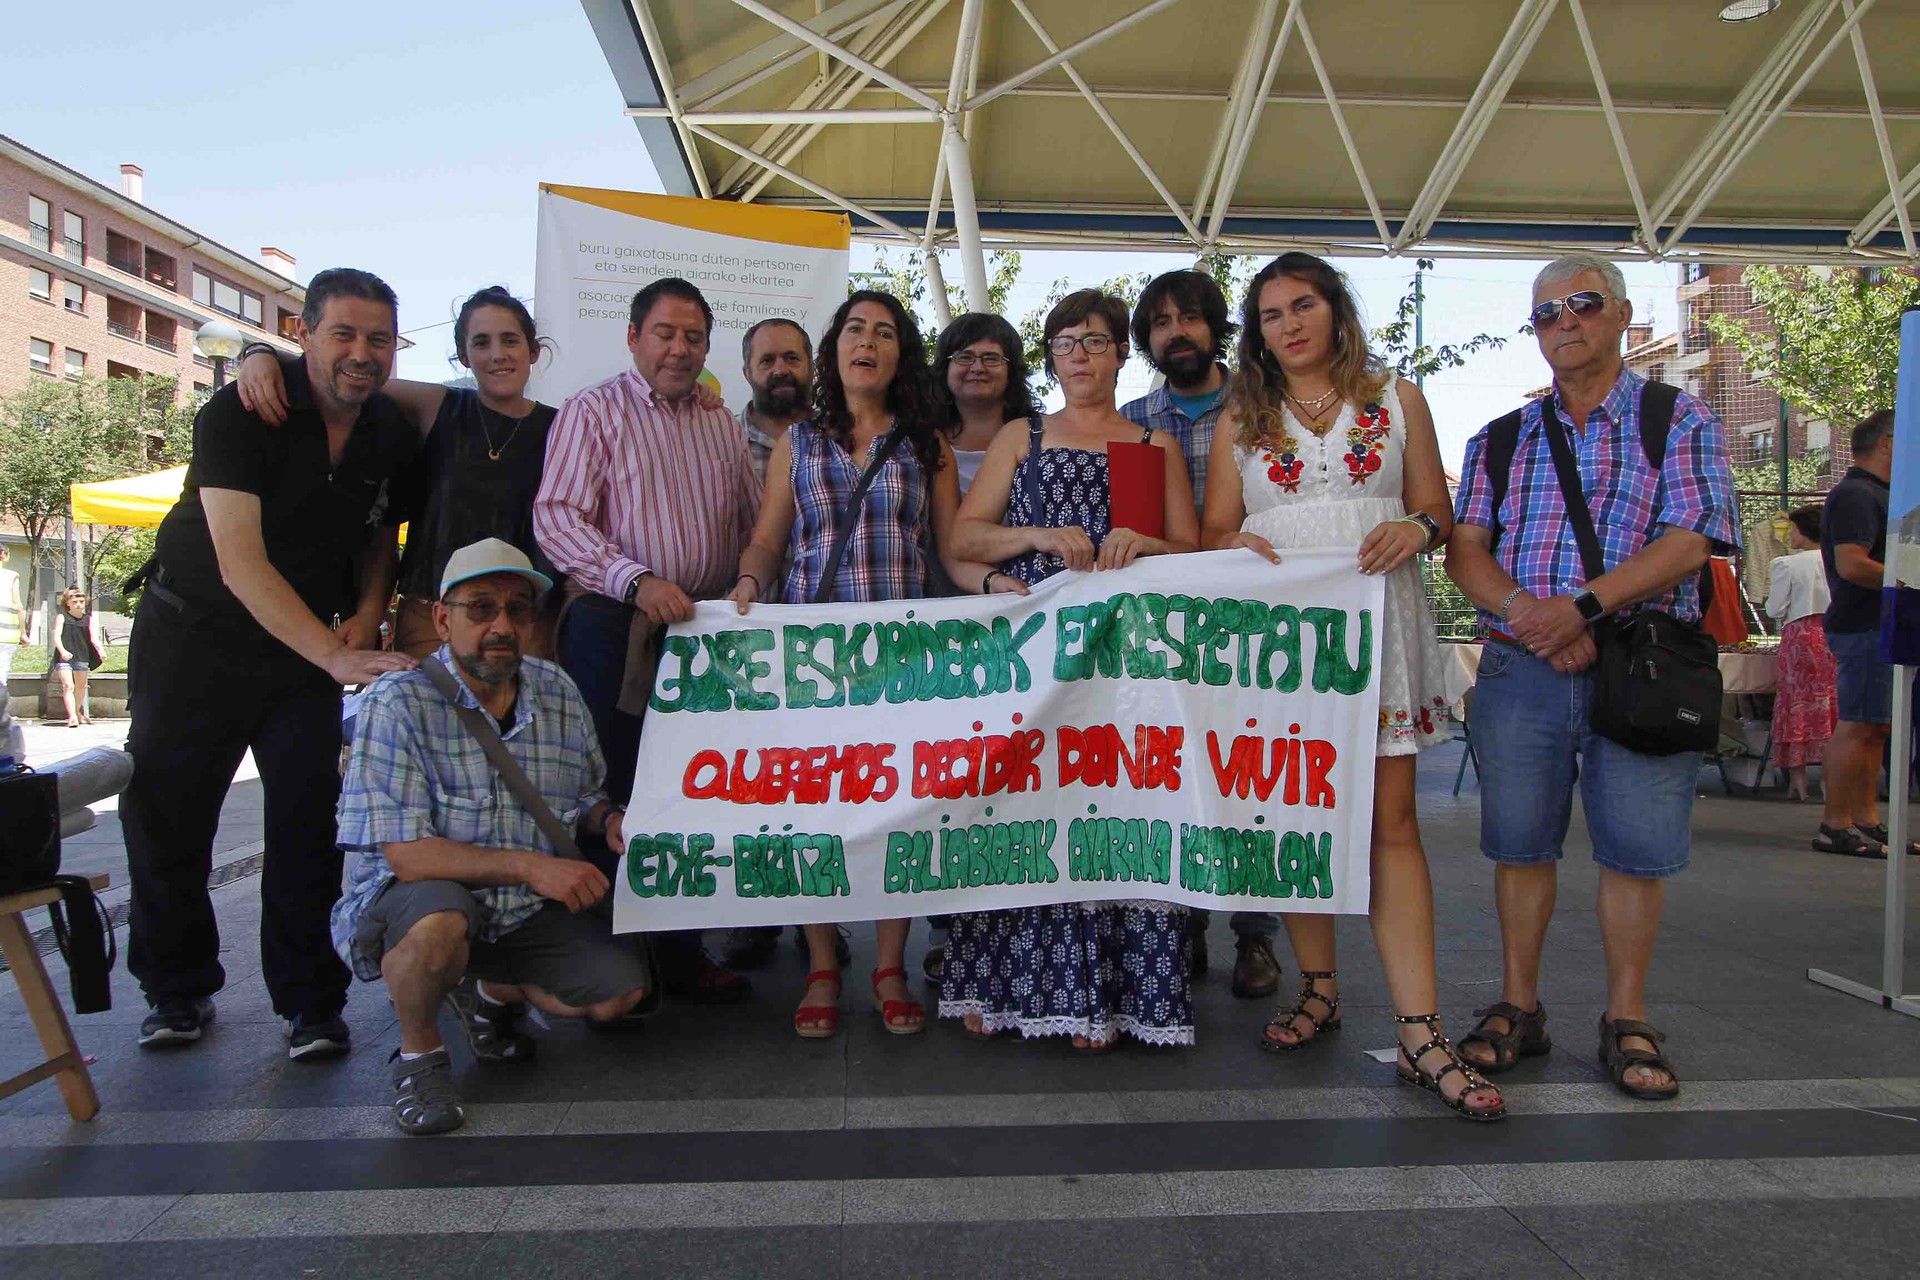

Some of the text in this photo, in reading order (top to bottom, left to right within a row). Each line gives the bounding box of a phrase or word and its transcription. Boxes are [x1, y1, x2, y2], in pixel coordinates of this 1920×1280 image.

[579, 242, 810, 272] buru gaixotasuna duten pertsonen
[594, 262, 794, 287] eta senideen aiarako elkartea
[578, 291, 808, 320] asociaci de familiares y
[649, 592, 1374, 713] GURE ESKUBIDEAK ERRESPETATU
[682, 712, 1337, 809] QUEREMOS DECIDIR DONDE VIVIR
[627, 823, 851, 898] ETXE-BIZITZA
[884, 805, 1059, 894] BALIABIDEAK
